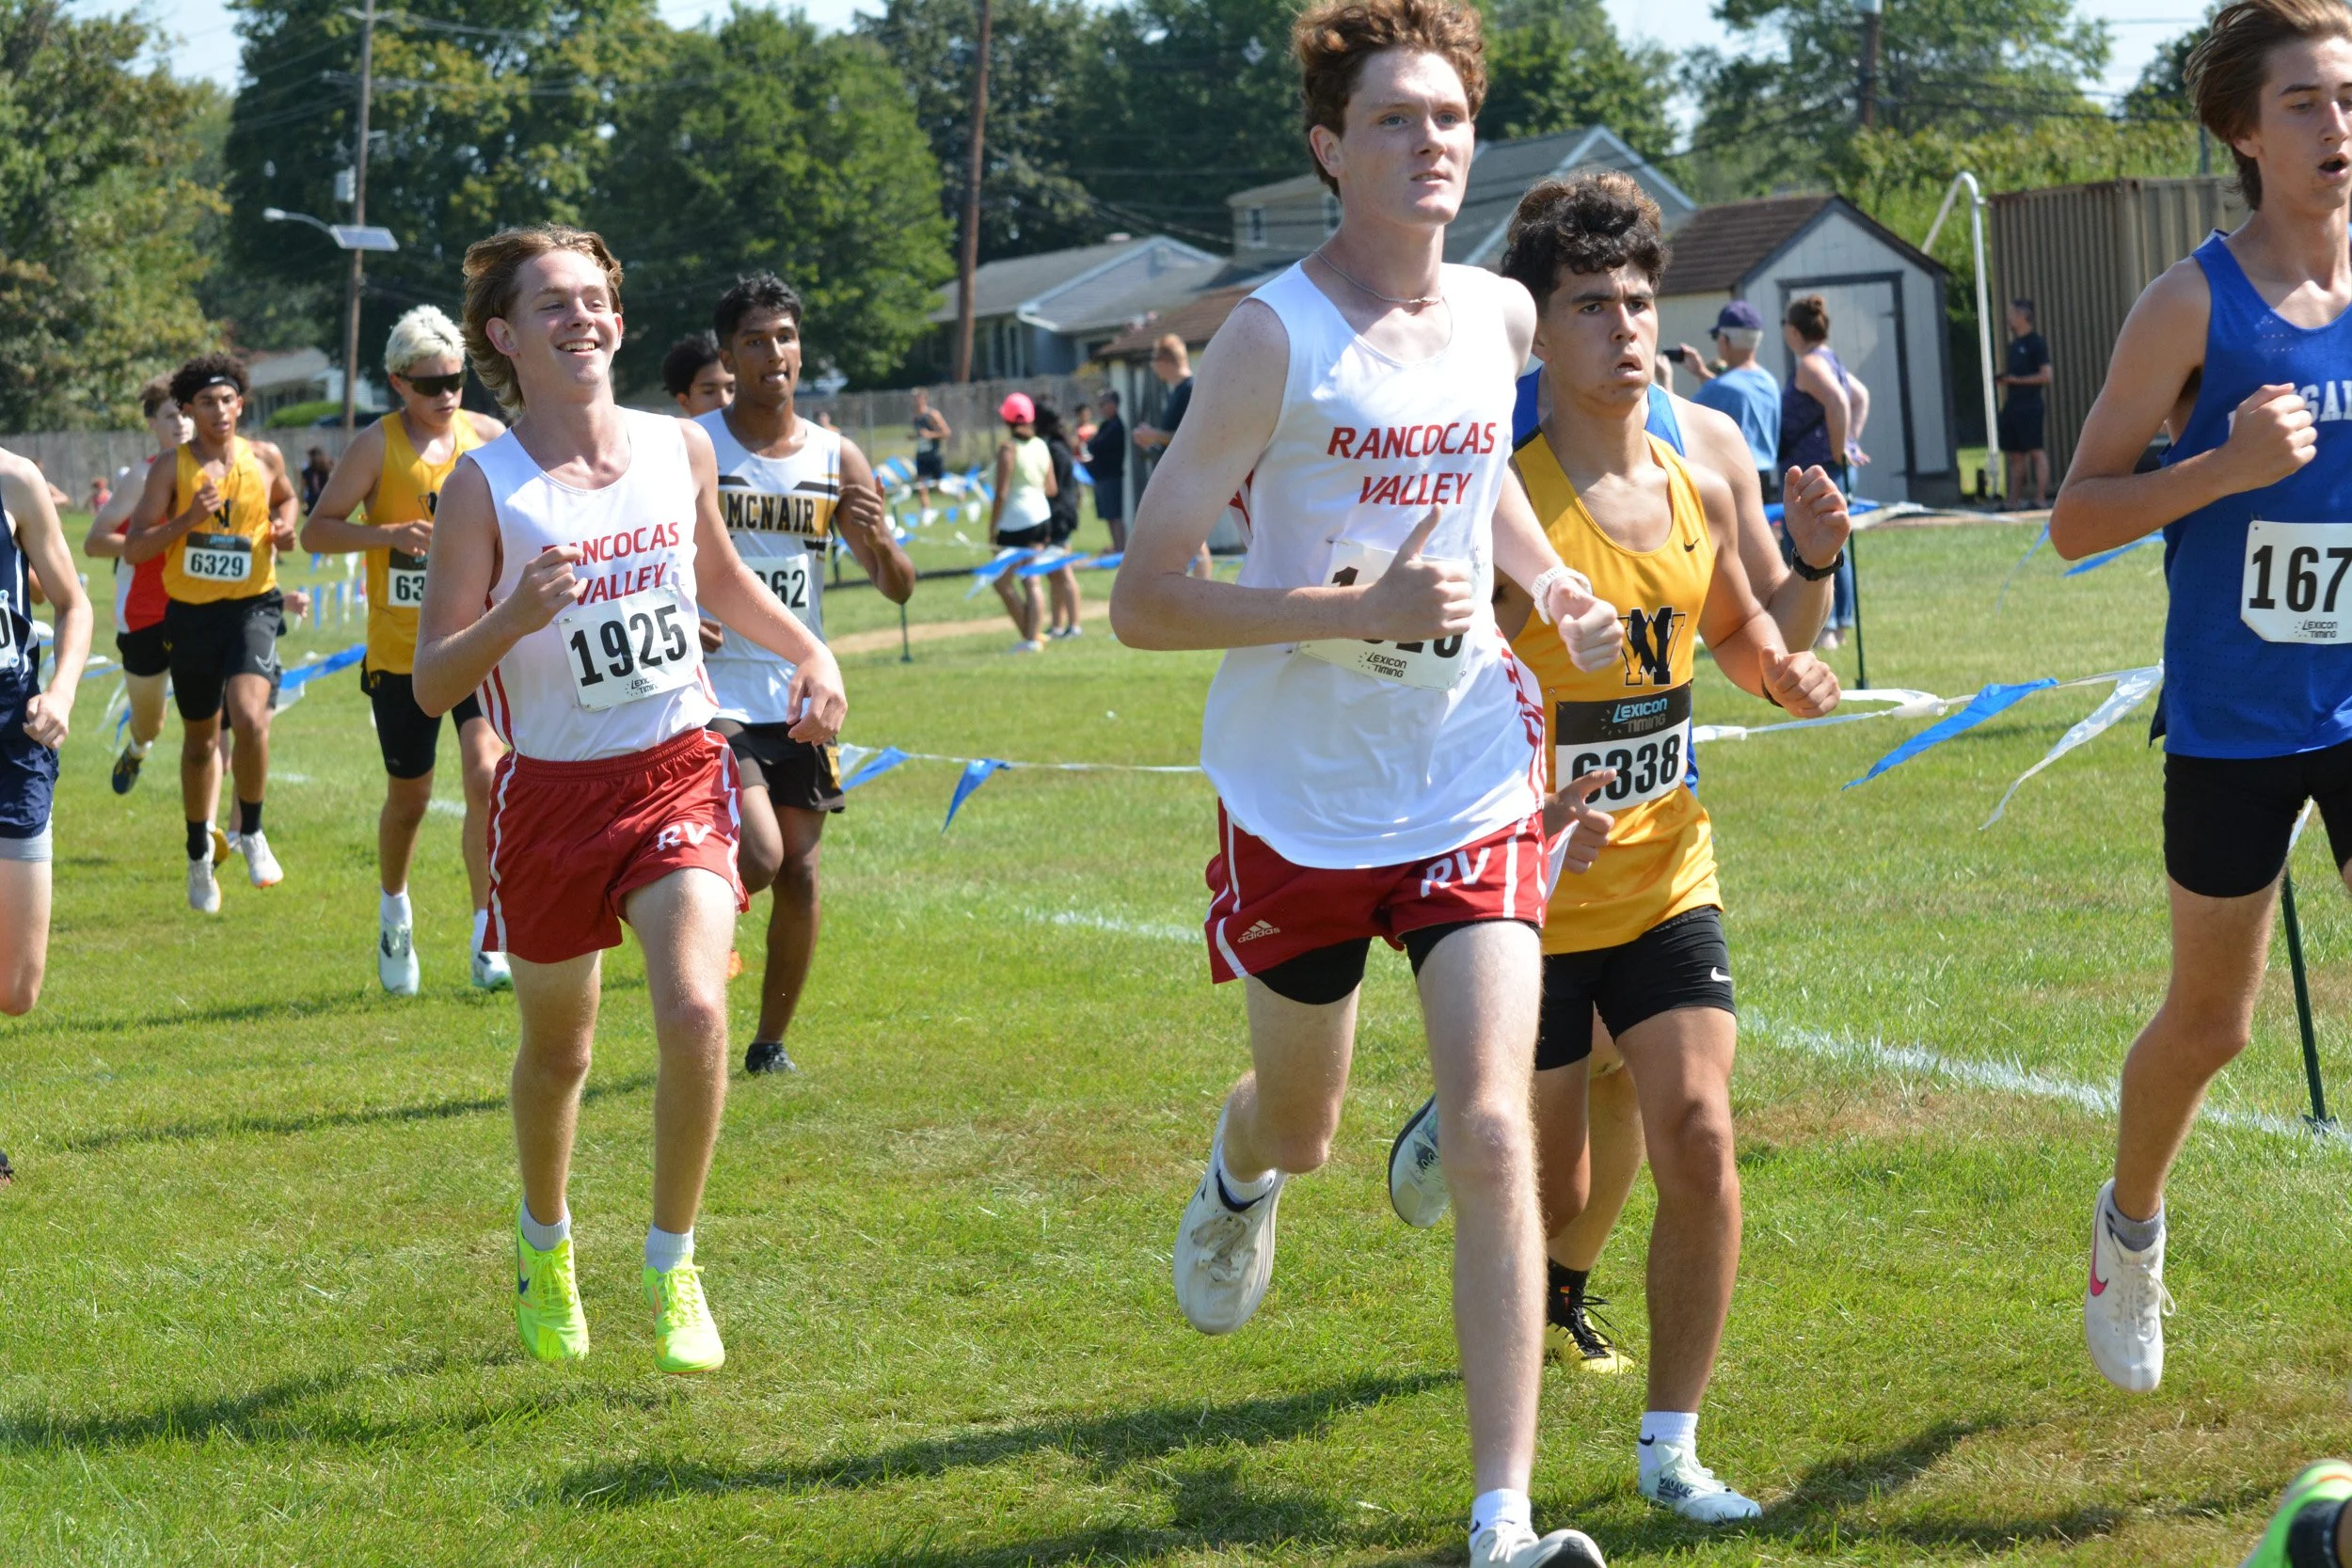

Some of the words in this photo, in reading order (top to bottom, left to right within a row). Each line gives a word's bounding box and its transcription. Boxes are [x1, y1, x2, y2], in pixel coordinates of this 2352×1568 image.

[1327, 422, 1497, 459] RANCOCAS
[1359, 472, 1472, 505] VALLEY
[726, 493, 815, 533] MCNAIR
[190, 553, 244, 578] 6329
[2249, 545, 2352, 612] 167
[576, 562, 667, 606] VALLEY
[754, 569, 806, 608] 62
[570, 604, 688, 687] 1925
[1366, 652, 1407, 669] LEXICON
[631, 677, 654, 689] LEXIC
[1372, 664, 1405, 678] TIMING
[1612, 698, 1668, 723] LEXICON
[1622, 714, 1667, 733] TIMING
[657, 821, 712, 851] RV
[1420, 847, 1490, 898] RV
[1237, 927, 1280, 943] adidas
